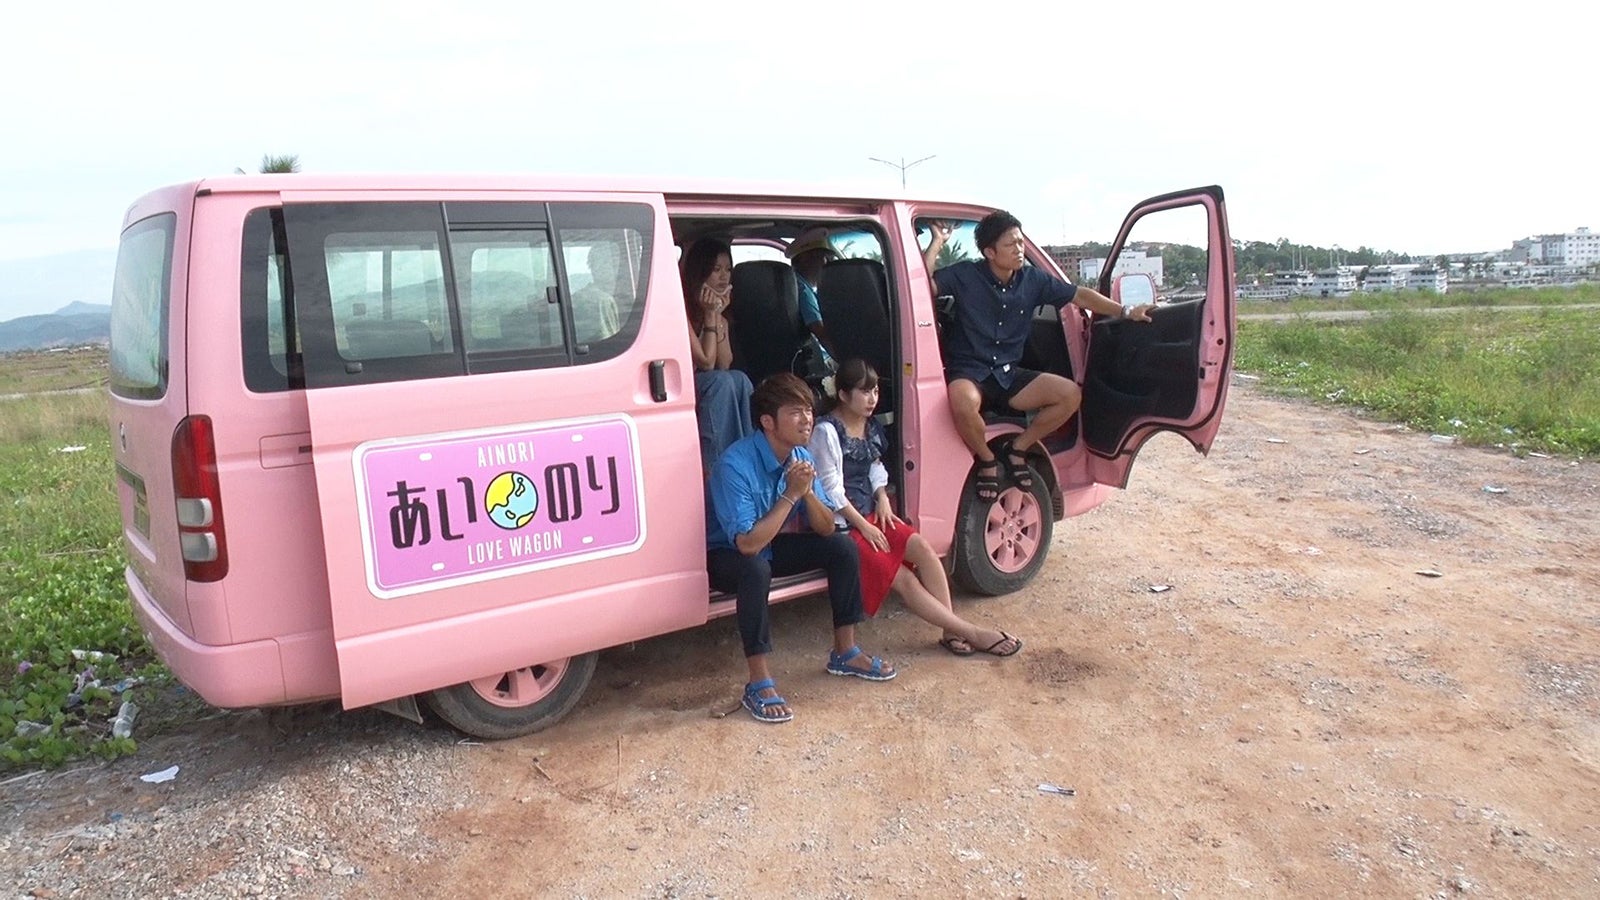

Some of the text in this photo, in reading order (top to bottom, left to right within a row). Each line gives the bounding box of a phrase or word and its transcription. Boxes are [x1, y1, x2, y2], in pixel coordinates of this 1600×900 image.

[477, 442, 535, 467] AINORI
[467, 530, 563, 565] LOVE WAGON
